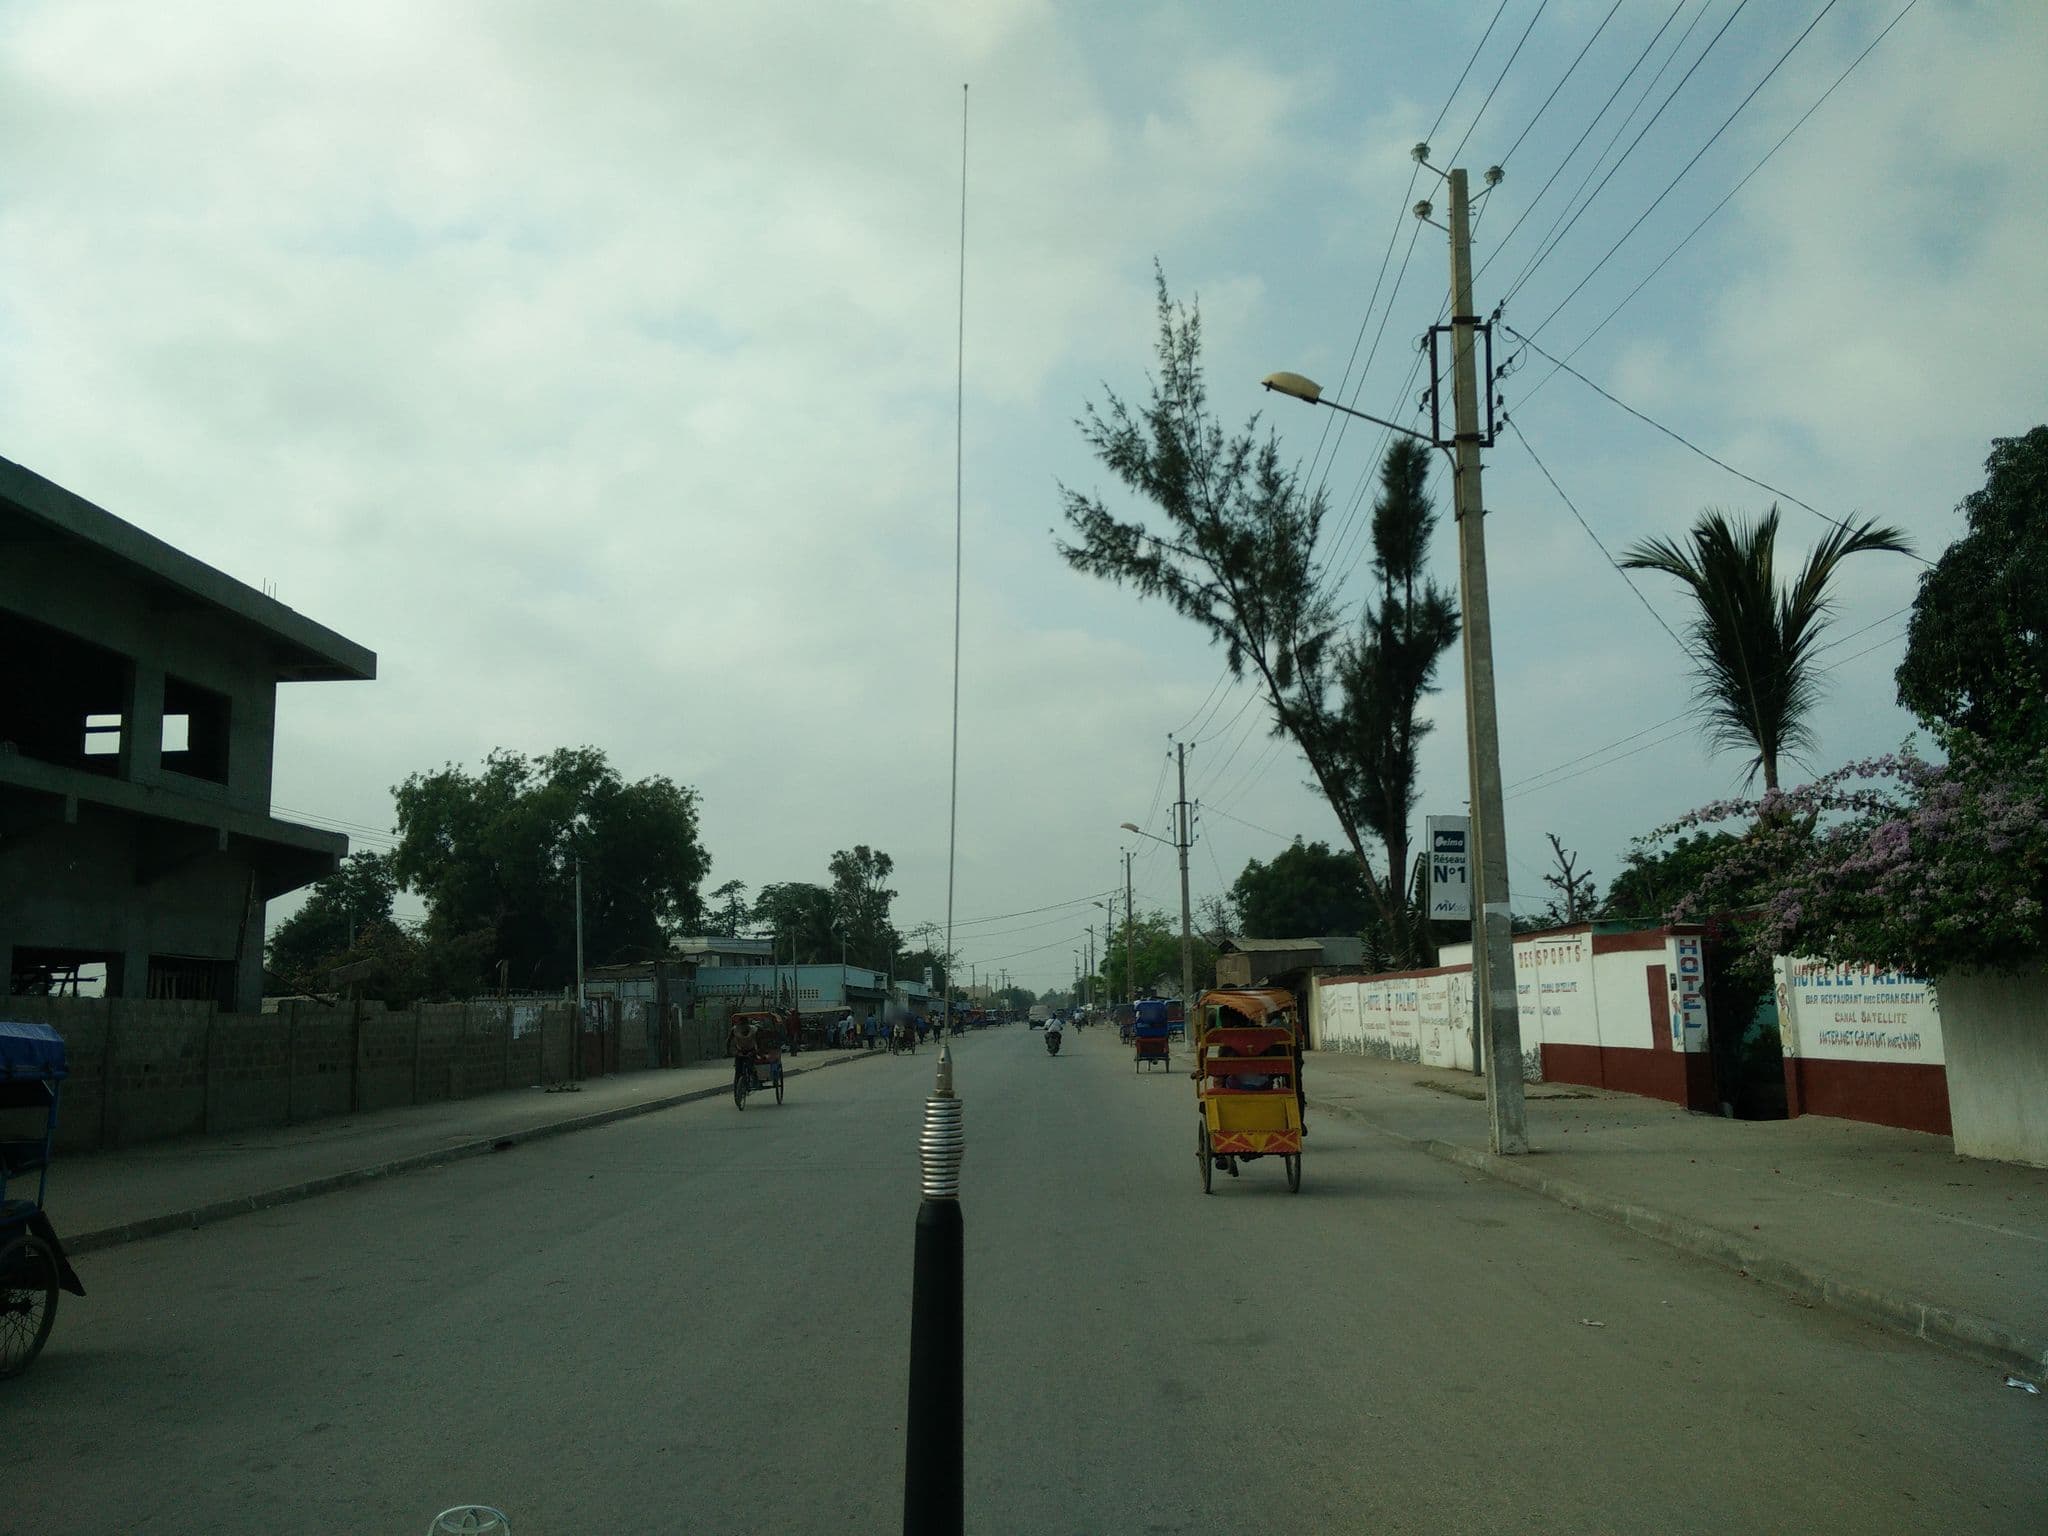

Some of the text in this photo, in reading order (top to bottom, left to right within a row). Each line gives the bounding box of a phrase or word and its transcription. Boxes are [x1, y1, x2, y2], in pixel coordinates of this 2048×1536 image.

[1433, 854, 1466, 864] Réseau
[1433, 865, 1466, 883] N°1
[1535, 945, 1581, 966] SPORTS
[1679, 939, 1702, 1028] HOTEL
[1820, 993, 1862, 1005] RESTAURANT
[1834, 1010, 1908, 1024] CANAL SATELLITE
